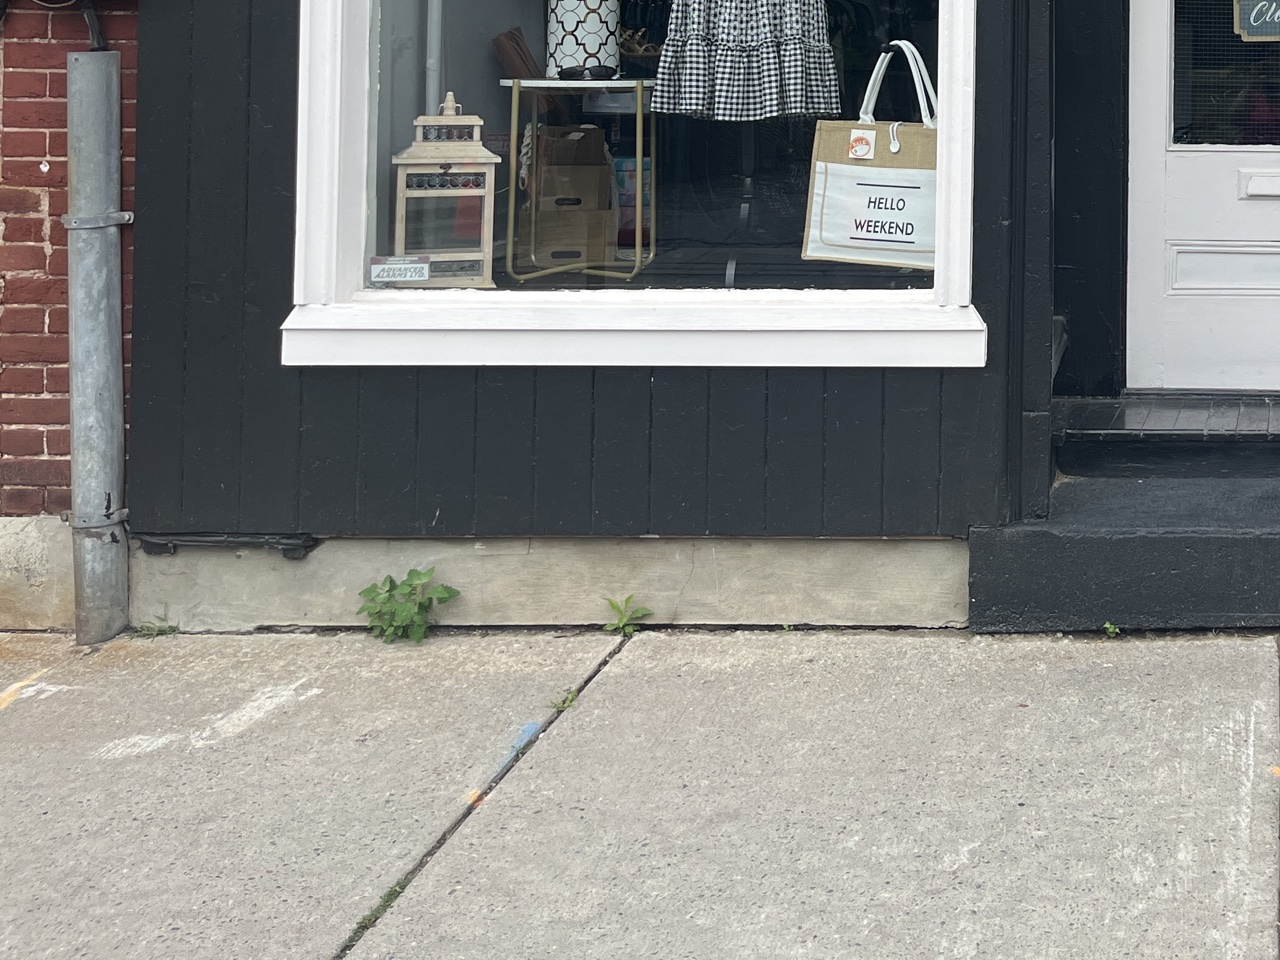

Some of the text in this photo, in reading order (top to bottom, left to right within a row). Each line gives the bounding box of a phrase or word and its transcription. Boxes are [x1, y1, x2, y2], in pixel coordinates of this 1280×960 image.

[867, 196, 906, 211] HELLO
[854, 219, 915, 236] WEEKEND
[374, 271, 409, 279] ALARMS
